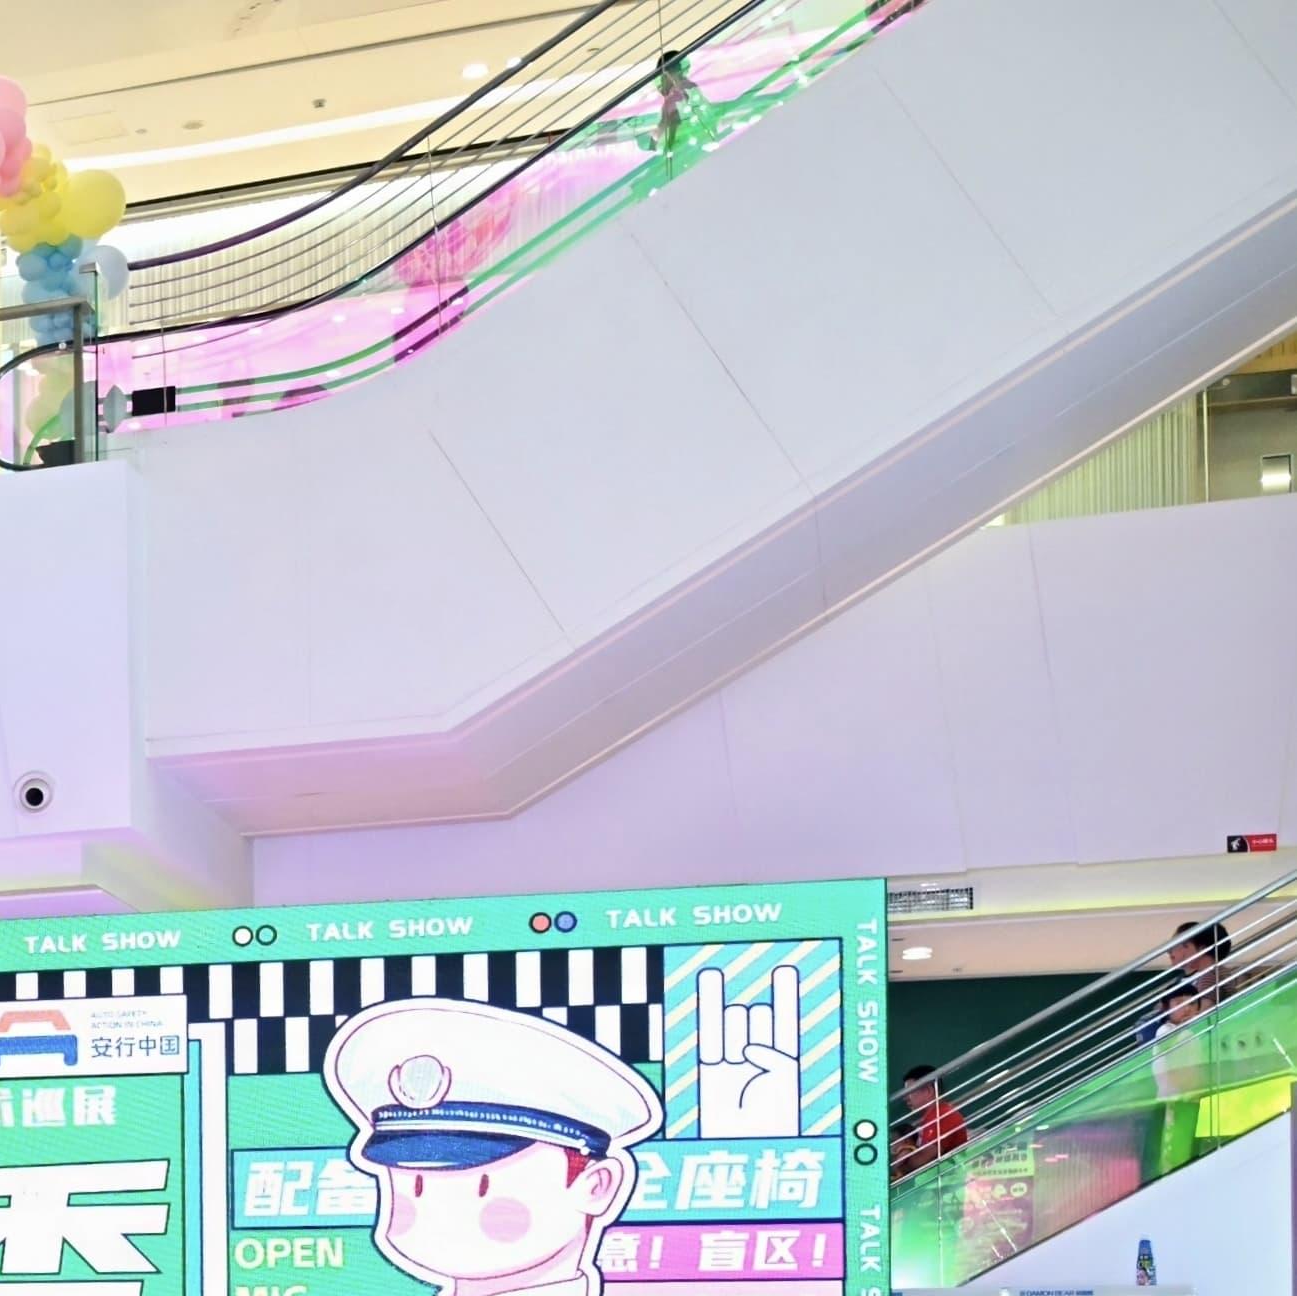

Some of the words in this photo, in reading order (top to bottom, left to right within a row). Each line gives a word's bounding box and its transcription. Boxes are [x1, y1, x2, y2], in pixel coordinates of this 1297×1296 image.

[307, 921, 374, 941] TALK
[389, 915, 474, 939] SHOW
[607, 907, 676, 929] TALK
[693, 903, 782, 926] SHOW
[24, 934, 88, 954] TALK
[101, 930, 182, 951] SHOW
[856, 918, 878, 985] TALK
[90, 1034, 181, 1059] 安行中国
[857, 1001, 879, 1083] SHOW
[243, 1160, 379, 1218] 配备
[233, 1238, 345, 1269] OPEN
[859, 1205, 881, 1273] TALK
